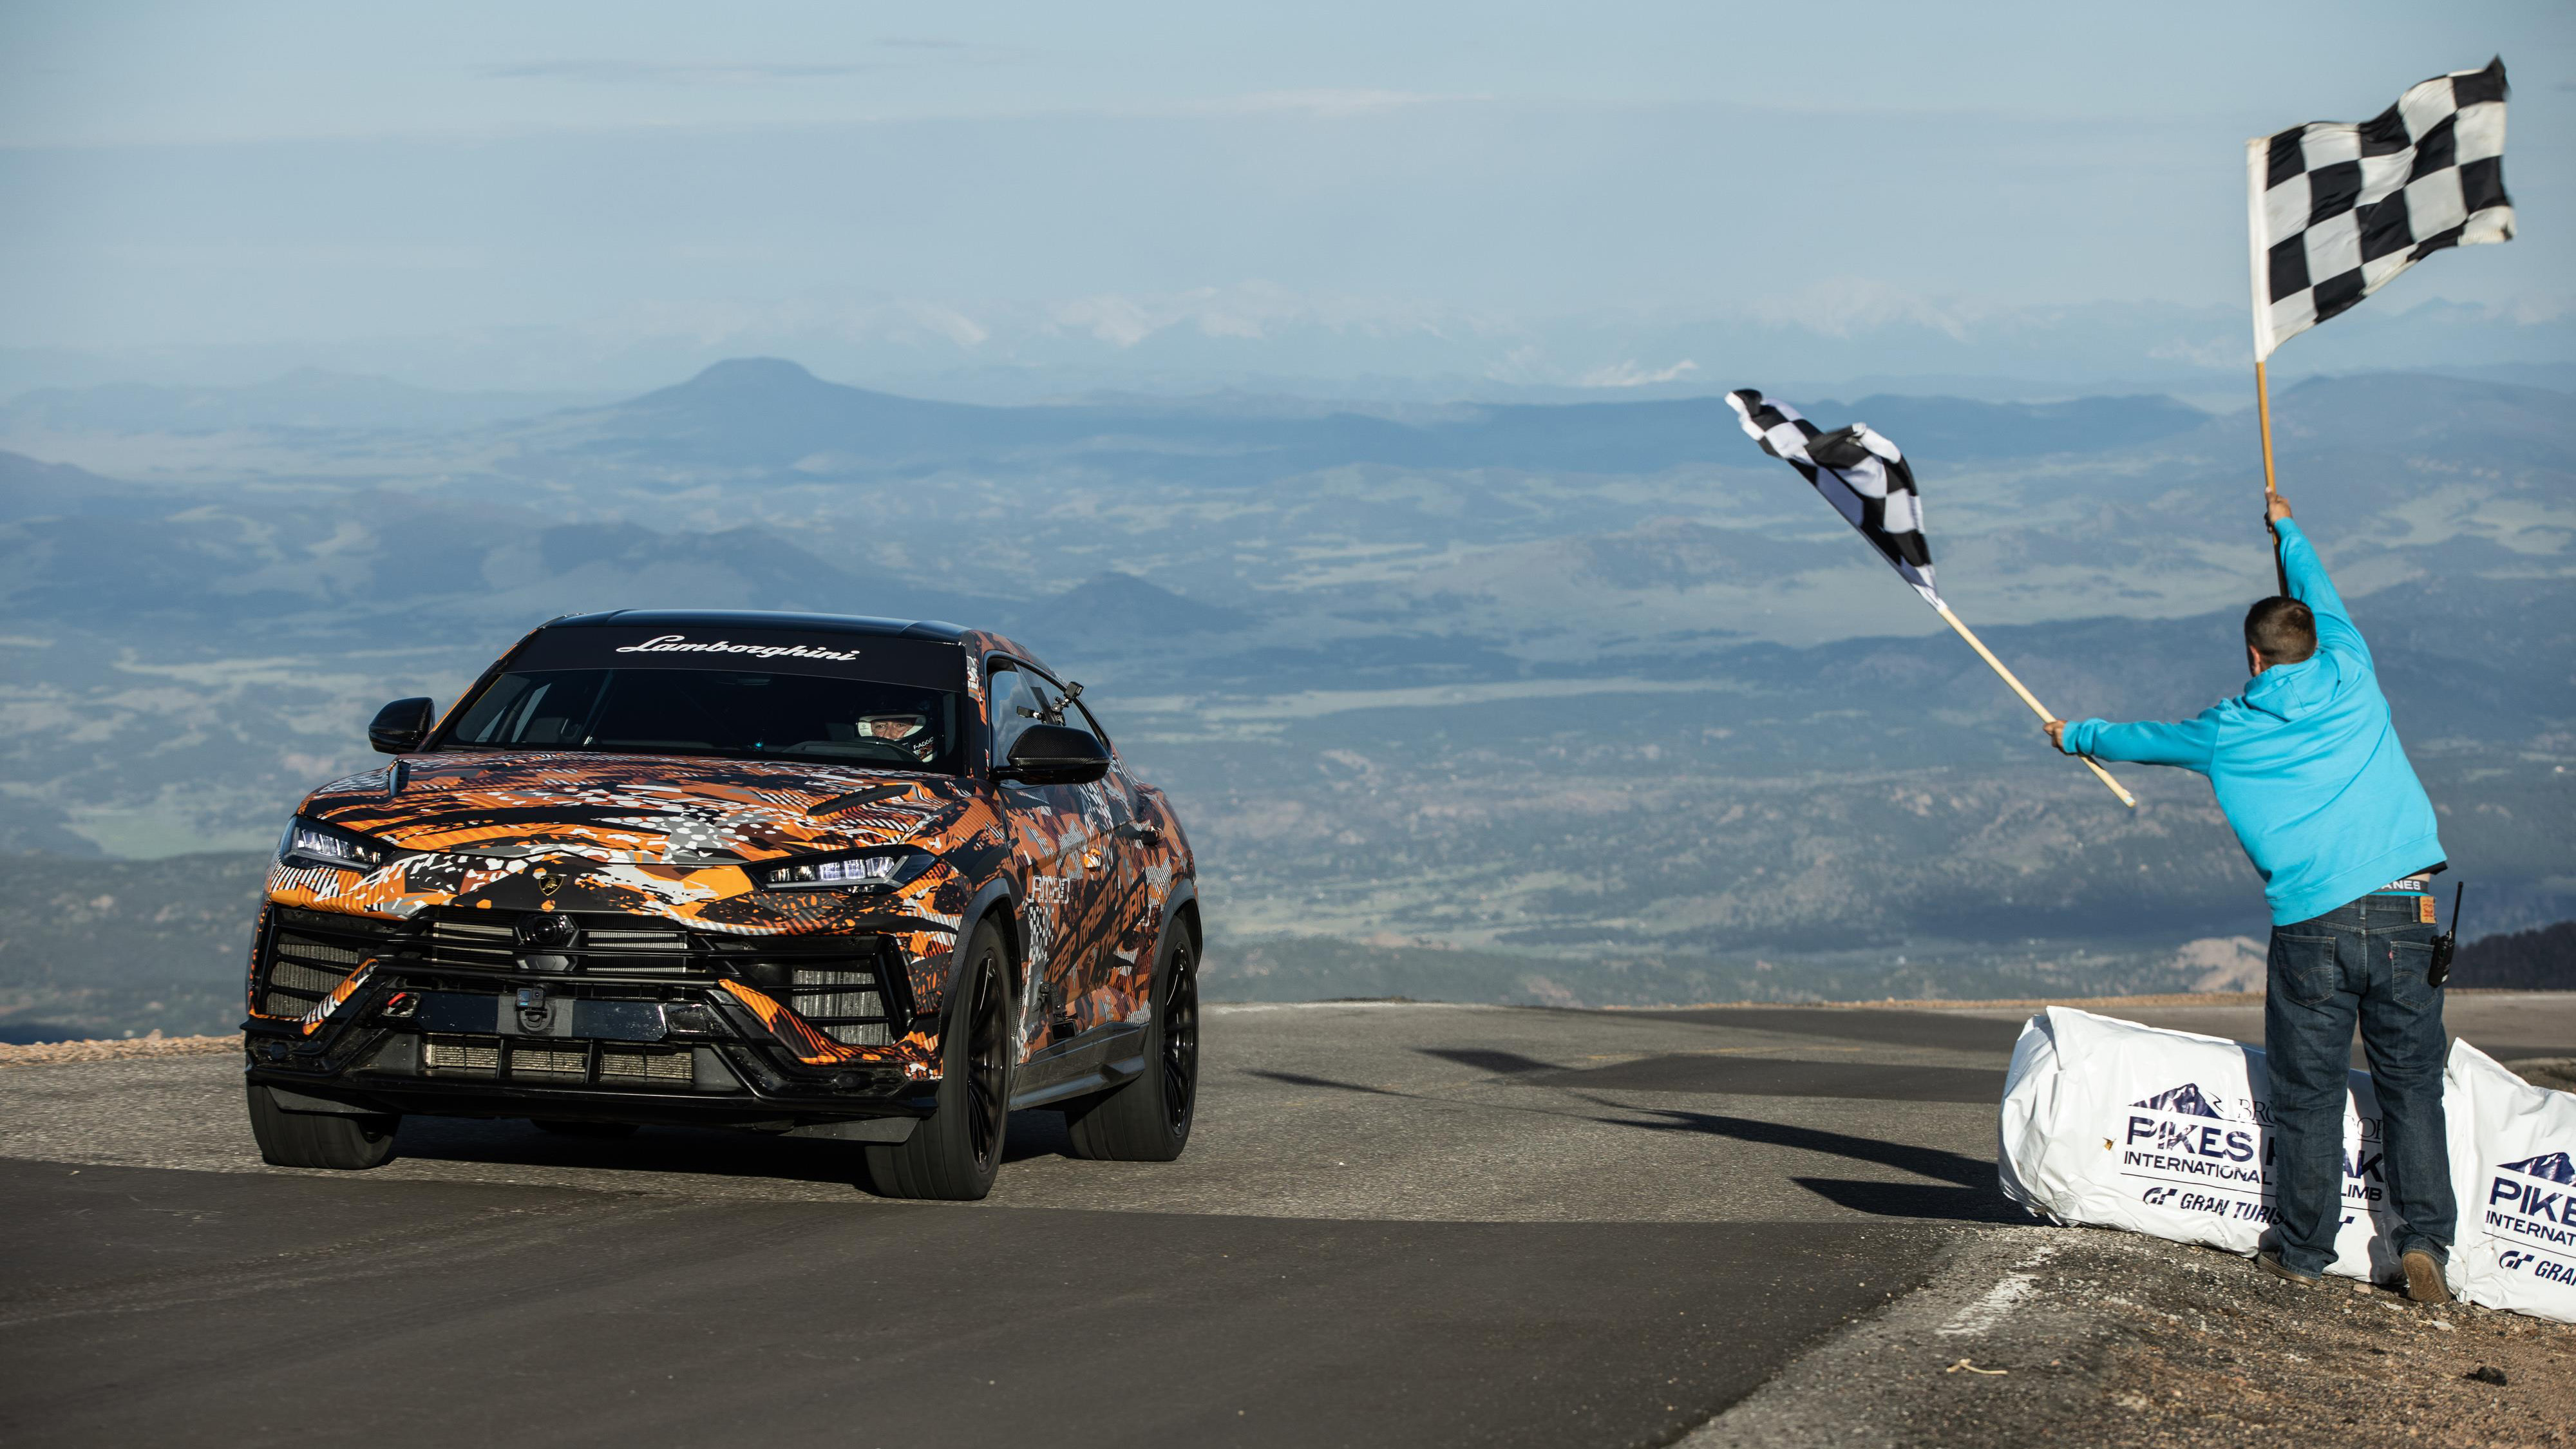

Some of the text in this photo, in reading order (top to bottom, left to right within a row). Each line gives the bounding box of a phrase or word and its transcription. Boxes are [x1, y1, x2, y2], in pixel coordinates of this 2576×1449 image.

[616, 635, 860, 661] Lamborghini
[913, 737, 934, 750] FAGGIO
[1079, 869, 1117, 950] RAISING
[1100, 882, 1146, 961] THE BAR
[2126, 1116, 2254, 1162] PIKES
[2124, 1151, 2273, 1186] INTERNATIONAL
[2180, 1193, 2230, 1216] GRAN
[2485, 1210, 2576, 1246] INTERNAT
[2534, 1260, 2576, 1287] GRA
